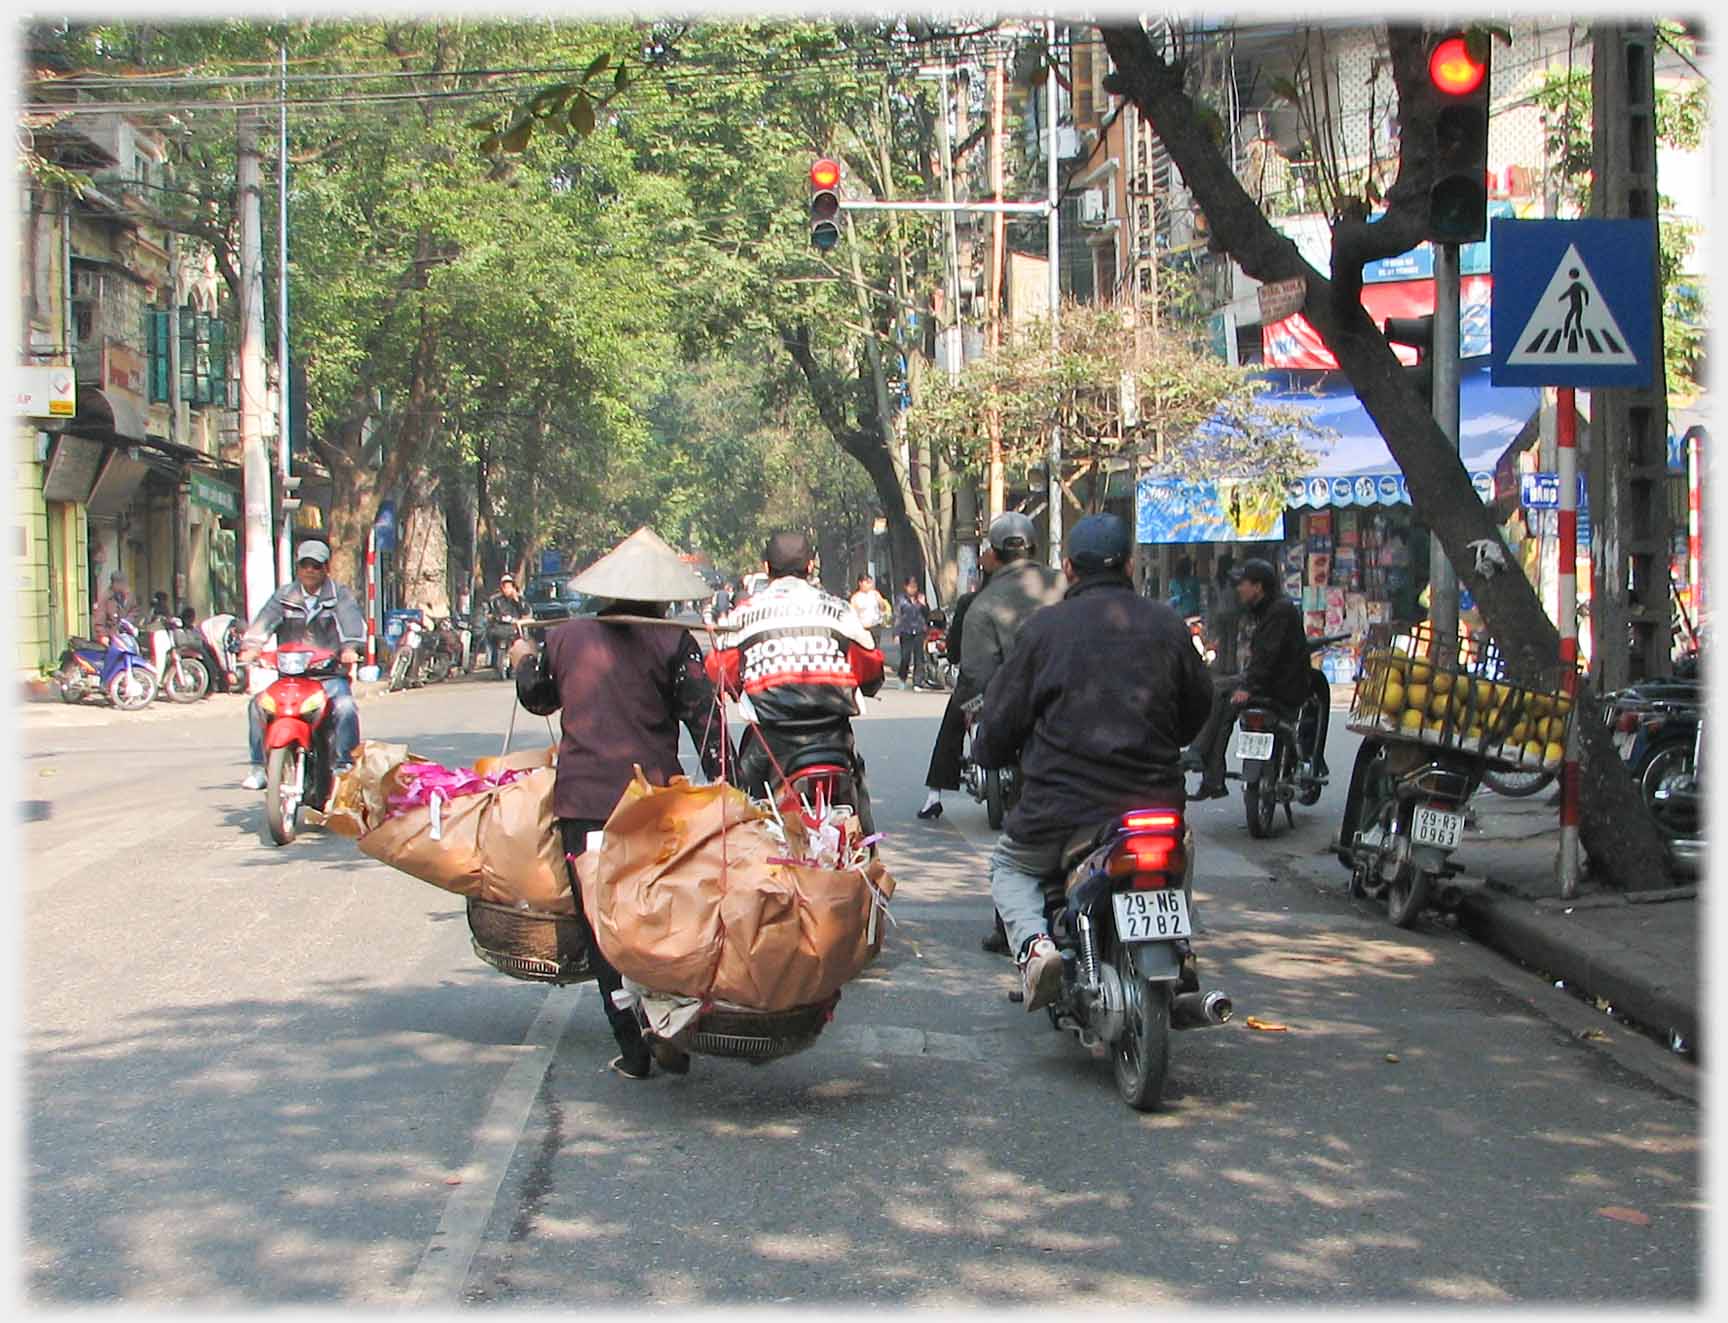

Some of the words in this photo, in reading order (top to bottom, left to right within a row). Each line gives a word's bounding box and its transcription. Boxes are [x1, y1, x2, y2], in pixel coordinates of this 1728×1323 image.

[1421, 811, 1457, 830] 29-R3
[1420, 826, 1454, 846] 0963
[1124, 893, 1179, 916] 29-N6
[1127, 915, 1182, 937] 2782
